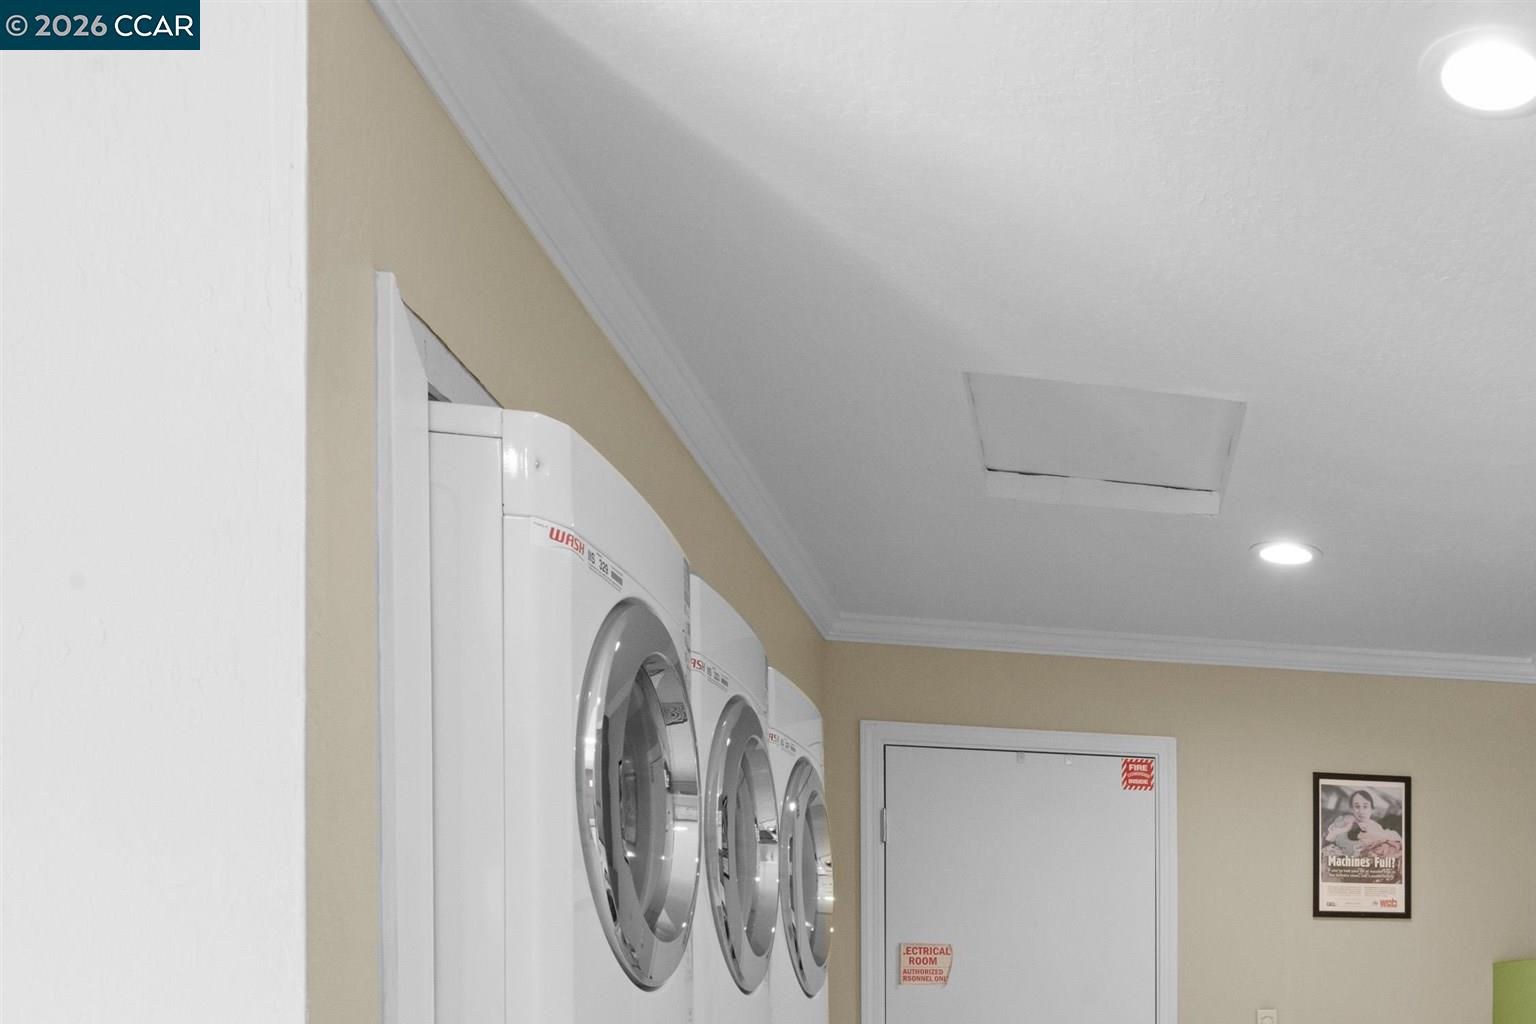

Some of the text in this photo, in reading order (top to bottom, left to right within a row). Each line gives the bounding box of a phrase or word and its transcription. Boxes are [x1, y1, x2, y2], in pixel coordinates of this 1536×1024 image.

[549, 527, 585, 556] WASH
[1128, 764, 1148, 772] FIRE
[1328, 855, 1396, 868] Machines Full?
[903, 946, 951, 956] ECTRICAL
[909, 956, 938, 966] ROOM
[903, 968, 944, 976] AUTHORIZED
